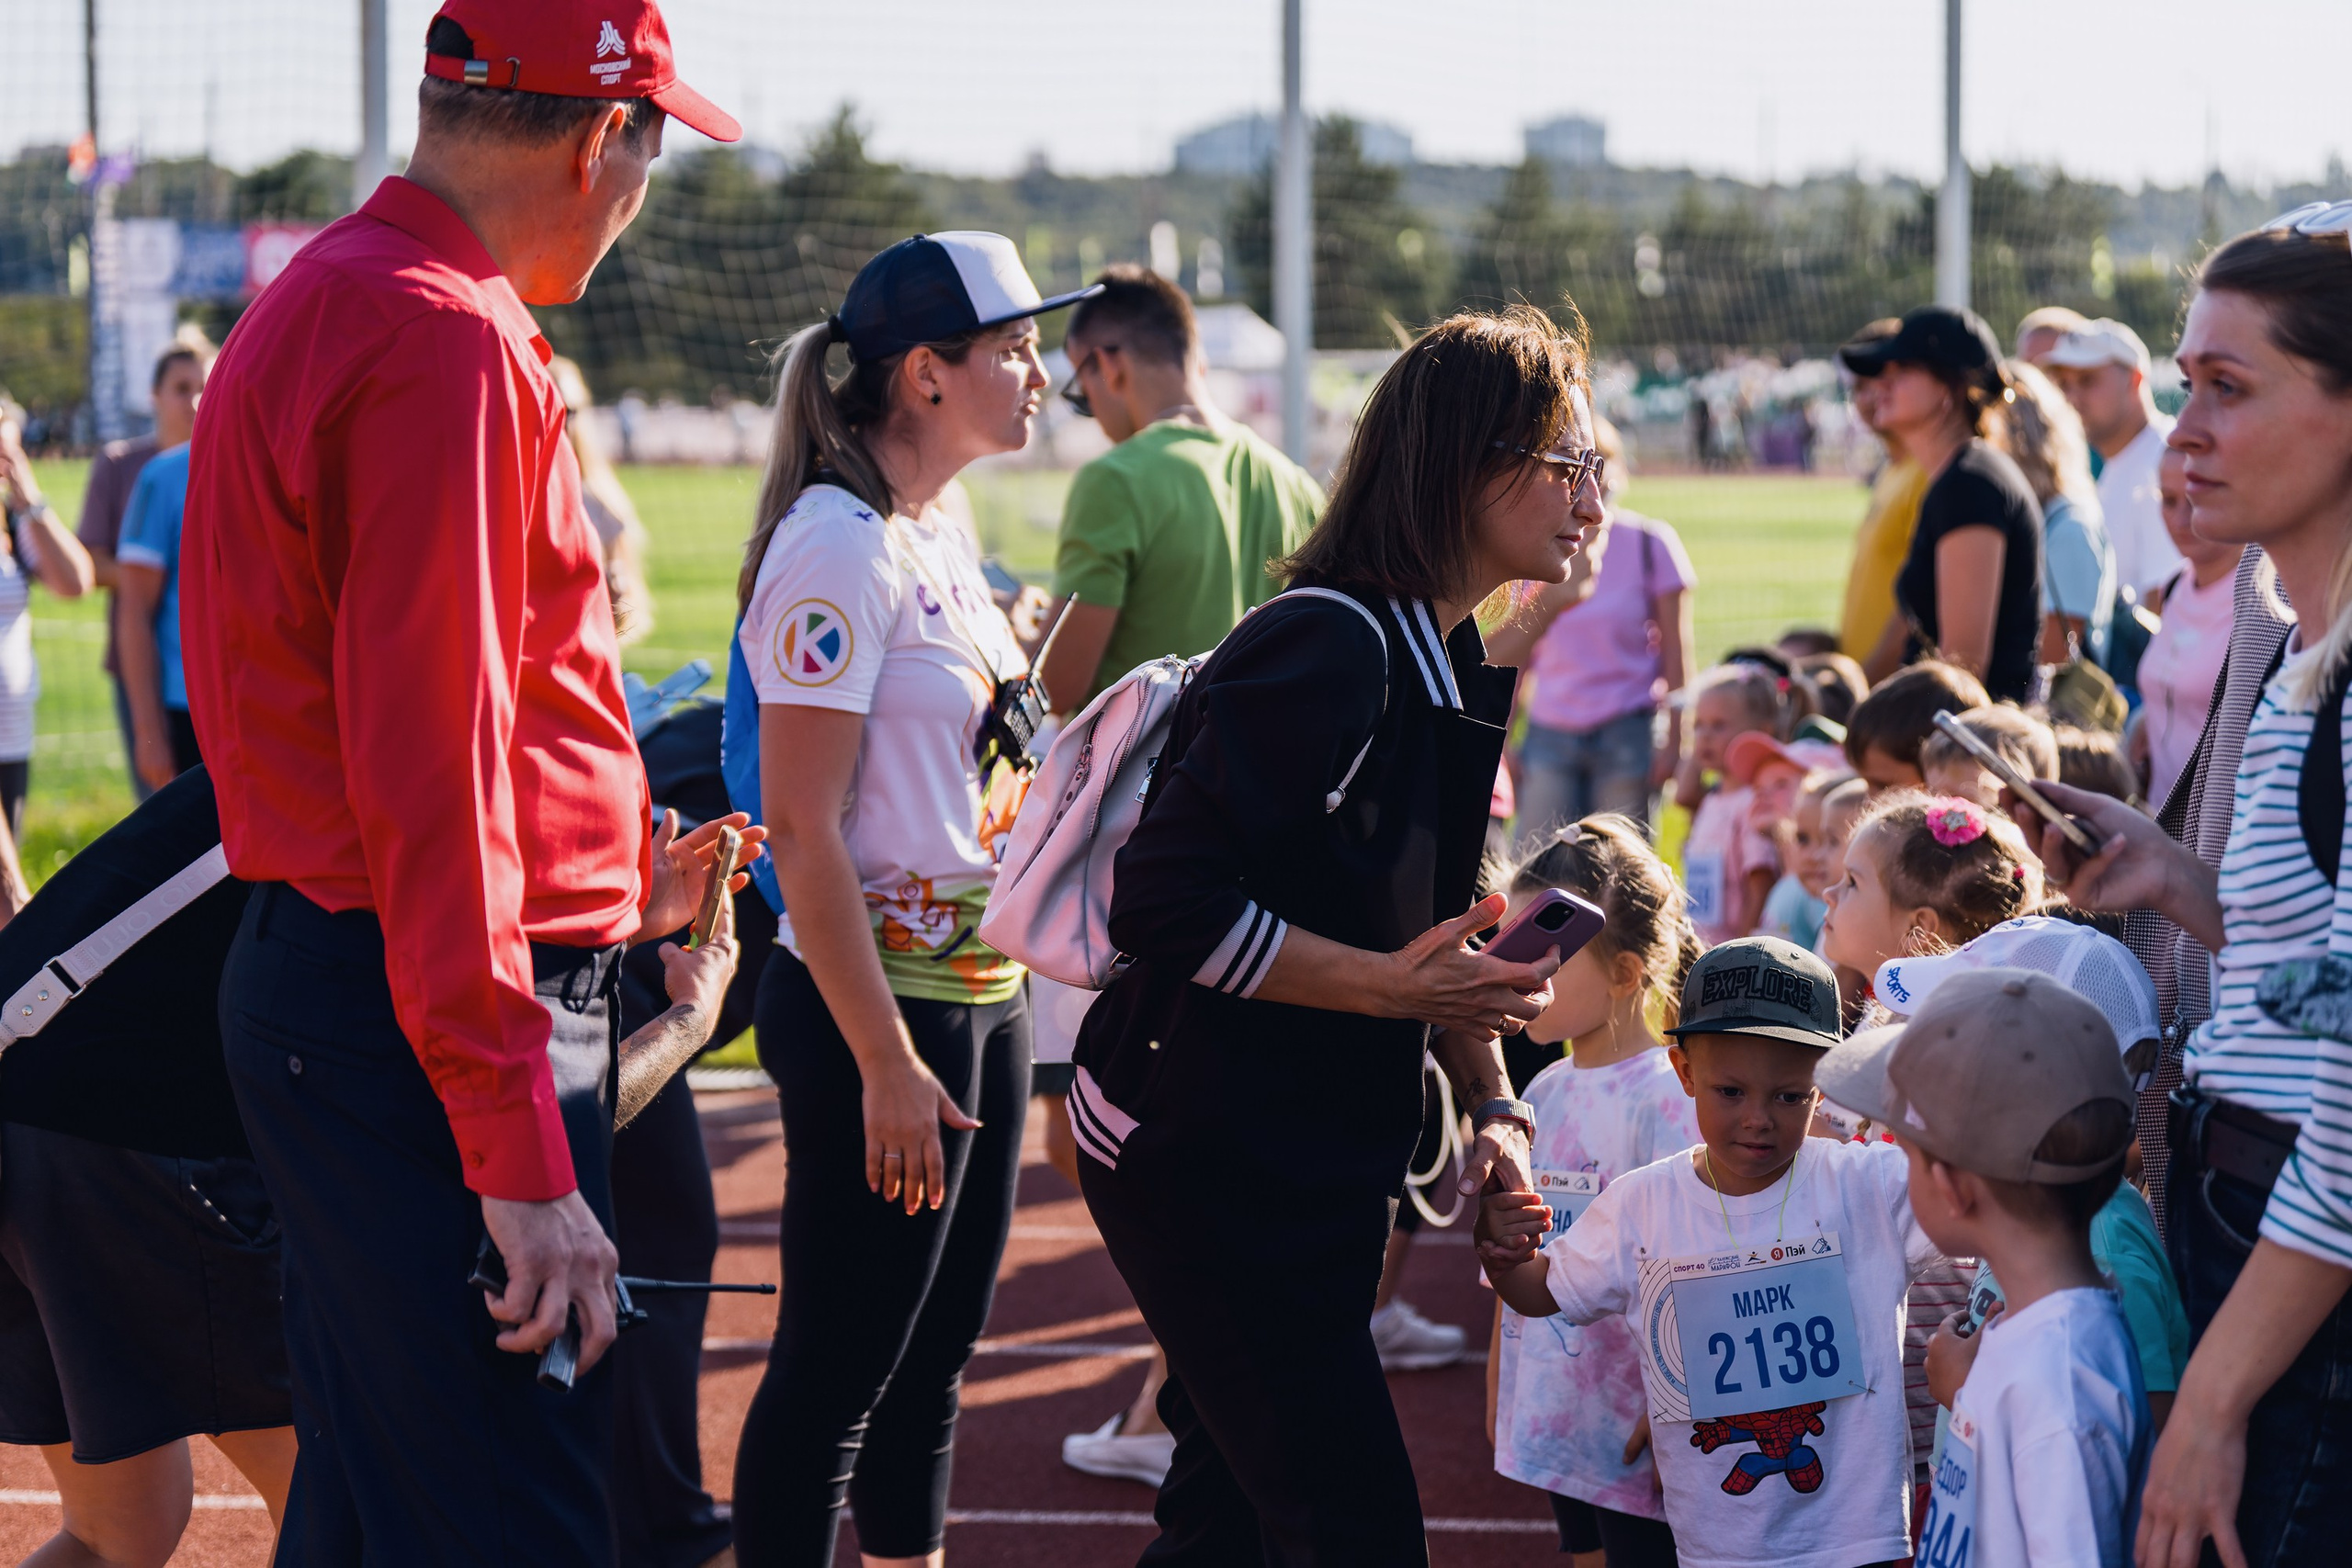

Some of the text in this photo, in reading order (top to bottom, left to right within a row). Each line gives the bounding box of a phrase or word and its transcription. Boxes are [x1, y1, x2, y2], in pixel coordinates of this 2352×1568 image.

[601, 73, 621, 85] СПОРТ
[1702, 965, 1814, 1013] EXPLORE
[1886, 966, 1911, 1003] SPORTS
[1552, 1209, 1572, 1233] НА
[1785, 1244, 1805, 1258] Пэй
[1673, 1264, 1695, 1273] СПОРТ
[1696, 1262, 1705, 1270] 40
[1711, 1261, 1741, 1272] МАРАФОН
[1732, 1283, 1795, 1318] МАРК
[1708, 1315, 1840, 1394] 2138
[1937, 1448, 1968, 1500] ЁДОР
